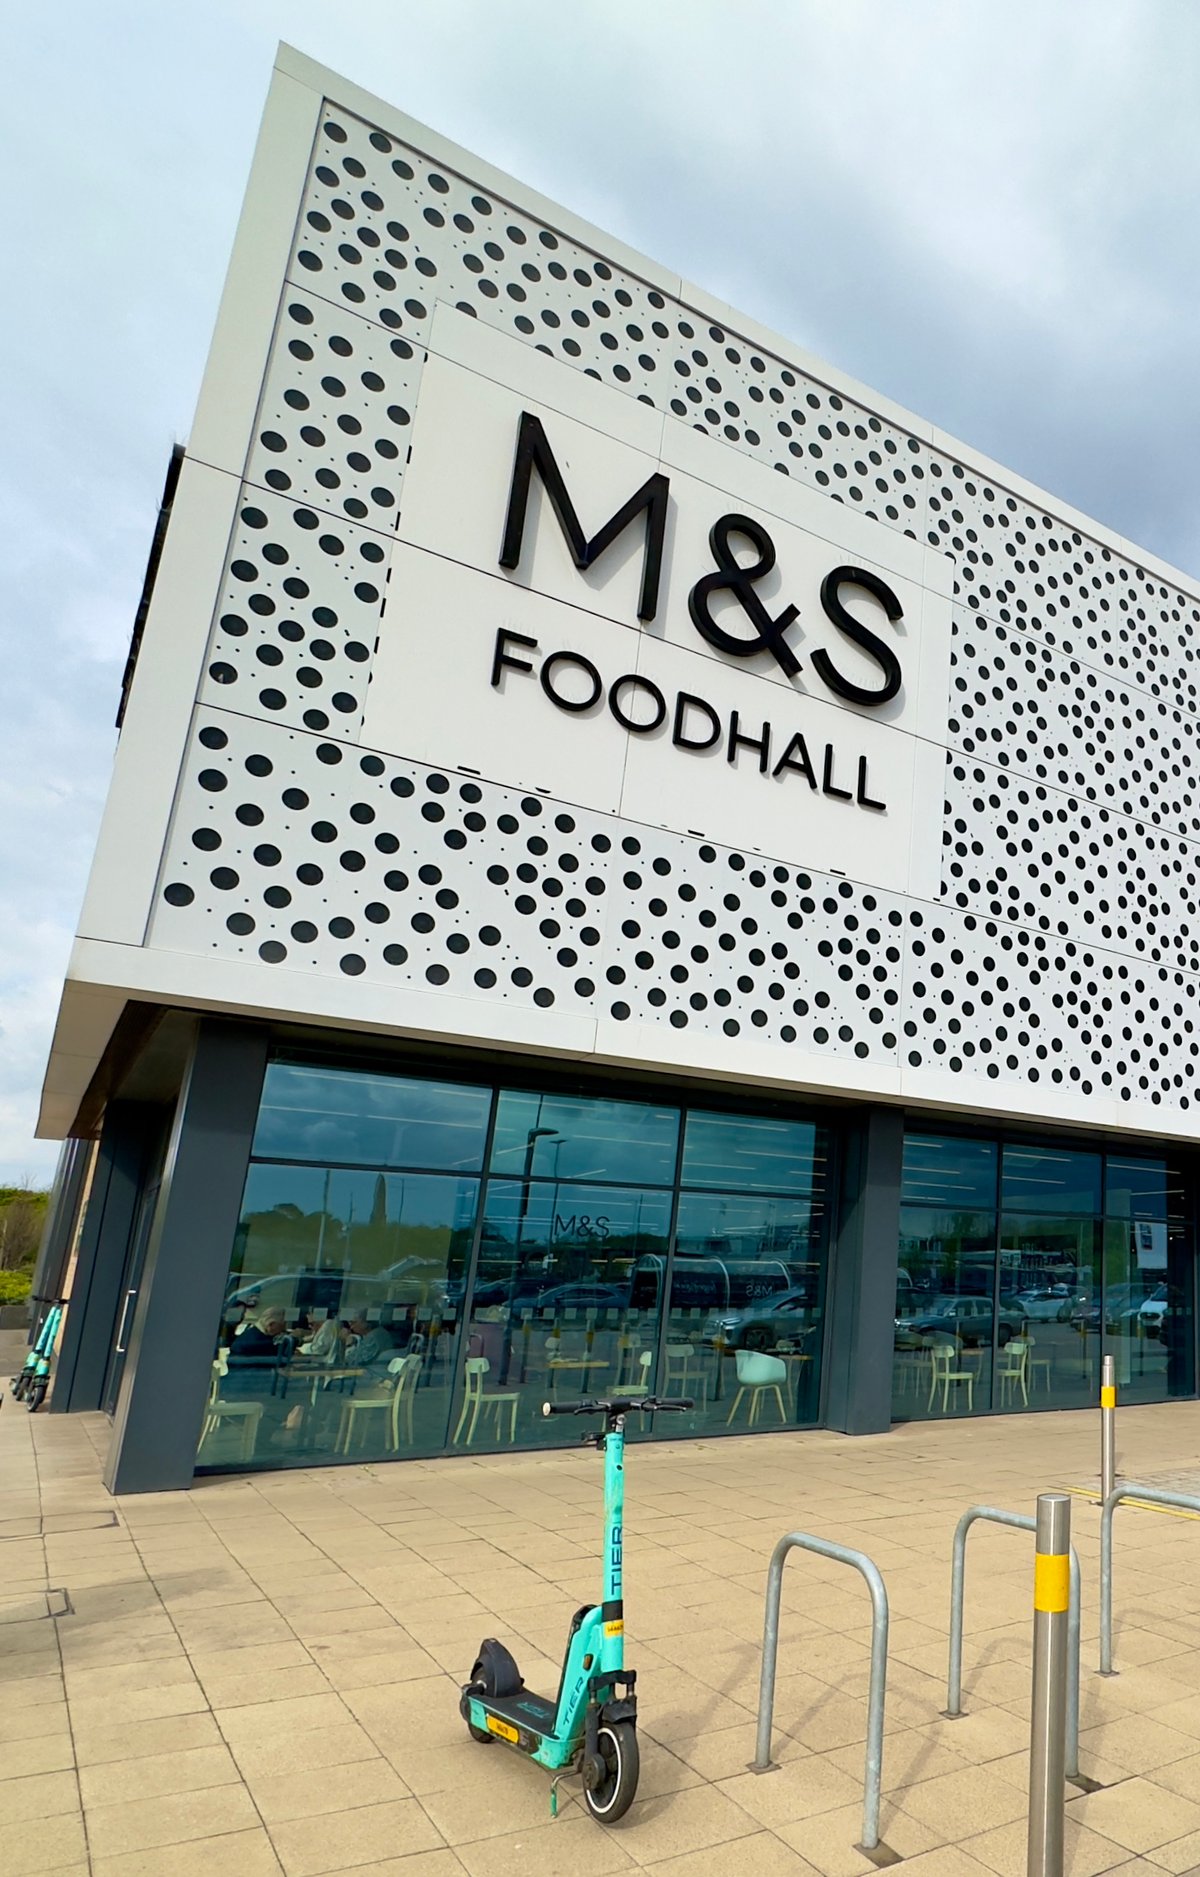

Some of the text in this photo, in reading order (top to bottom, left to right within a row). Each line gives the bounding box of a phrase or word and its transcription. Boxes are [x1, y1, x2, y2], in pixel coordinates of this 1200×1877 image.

[498, 410, 904, 706] M&S
[491, 627, 887, 811] FOODHALL
[554, 1214, 610, 1238] M&S
[611, 1525, 623, 1596] TIER
[563, 1676, 584, 1726] TIER
